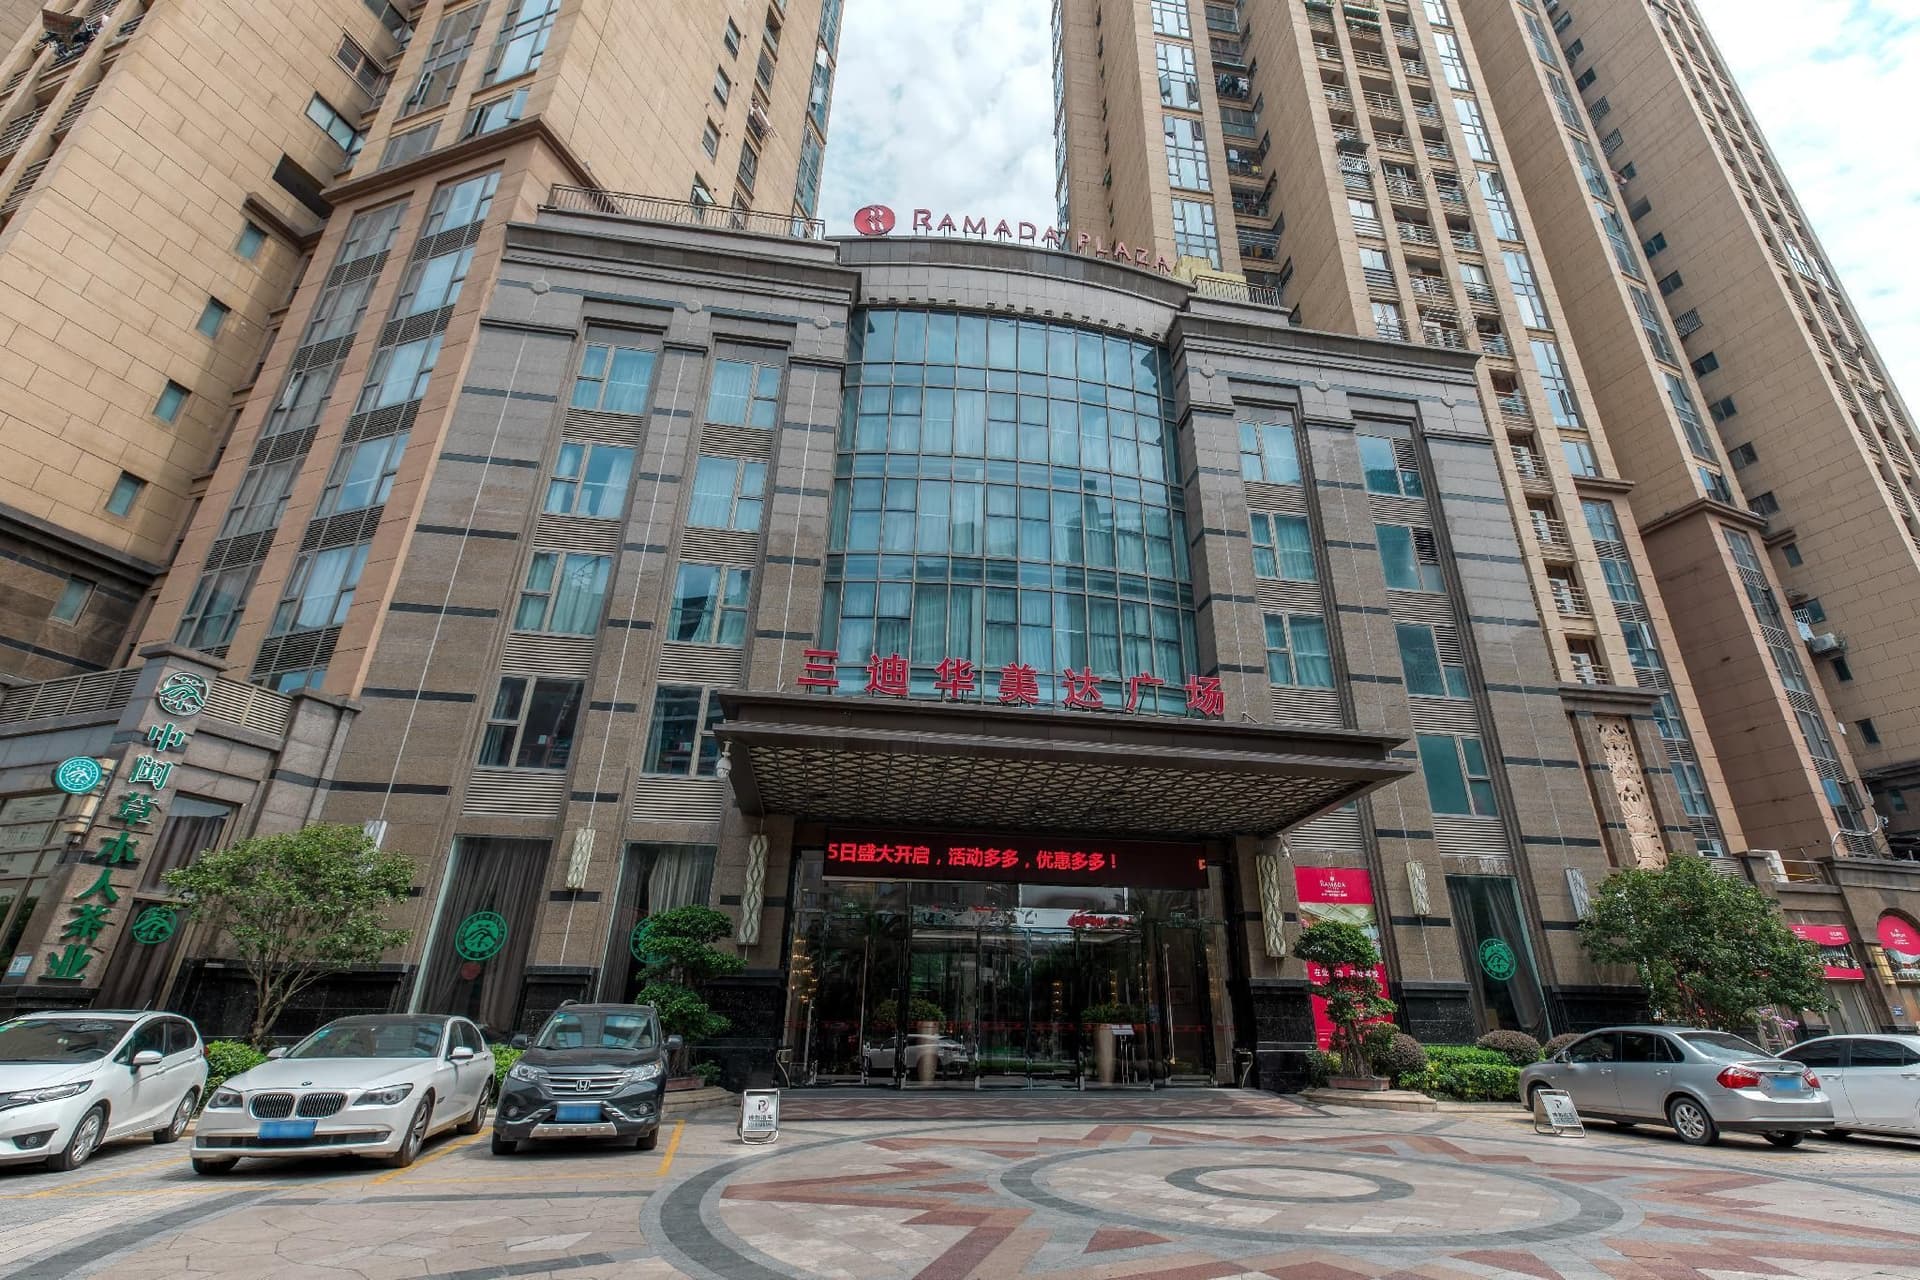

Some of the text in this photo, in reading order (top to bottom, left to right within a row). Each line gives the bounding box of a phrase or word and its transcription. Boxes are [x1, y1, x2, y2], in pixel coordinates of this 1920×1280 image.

[912, 208, 1171, 273] RAMADA PLAZA
[797, 649, 1226, 716] 三迪华美达广场
